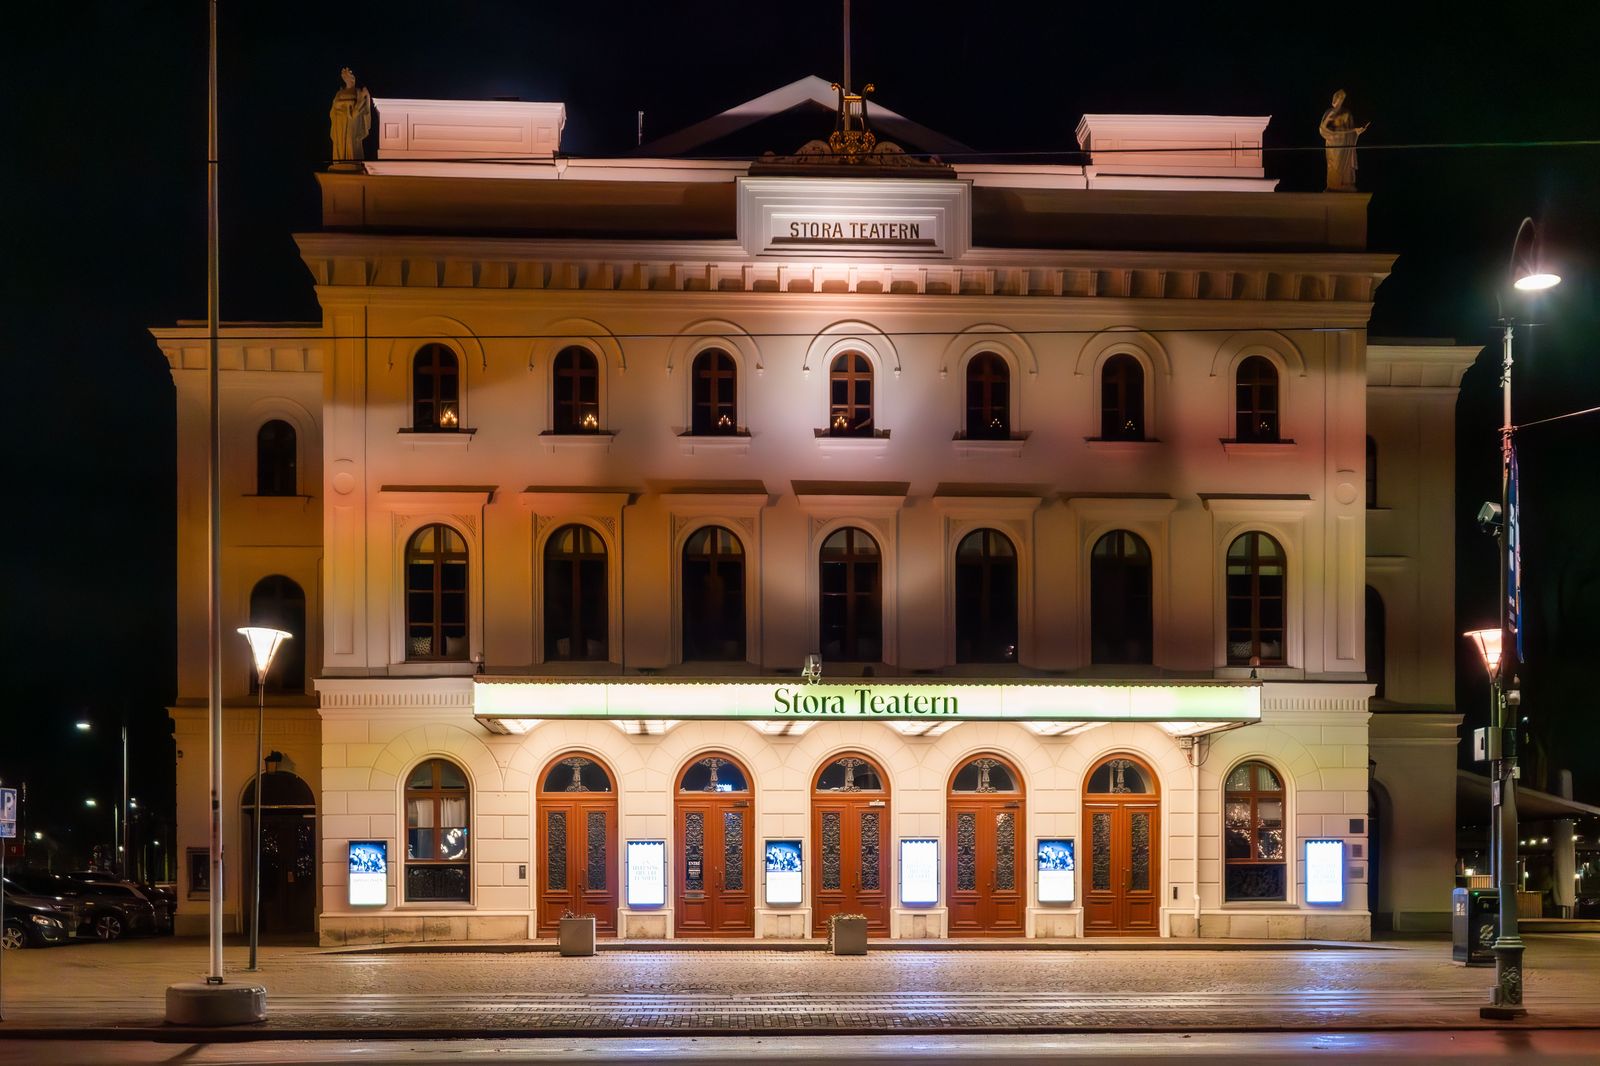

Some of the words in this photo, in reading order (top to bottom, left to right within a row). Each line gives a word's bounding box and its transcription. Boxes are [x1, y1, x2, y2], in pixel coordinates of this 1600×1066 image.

[790, 221, 843, 238] STORA
[850, 222, 920, 239] TEATERN
[774, 687, 845, 714] Stora
[854, 688, 959, 714] Teatern
[4, 792, 14, 818] P
